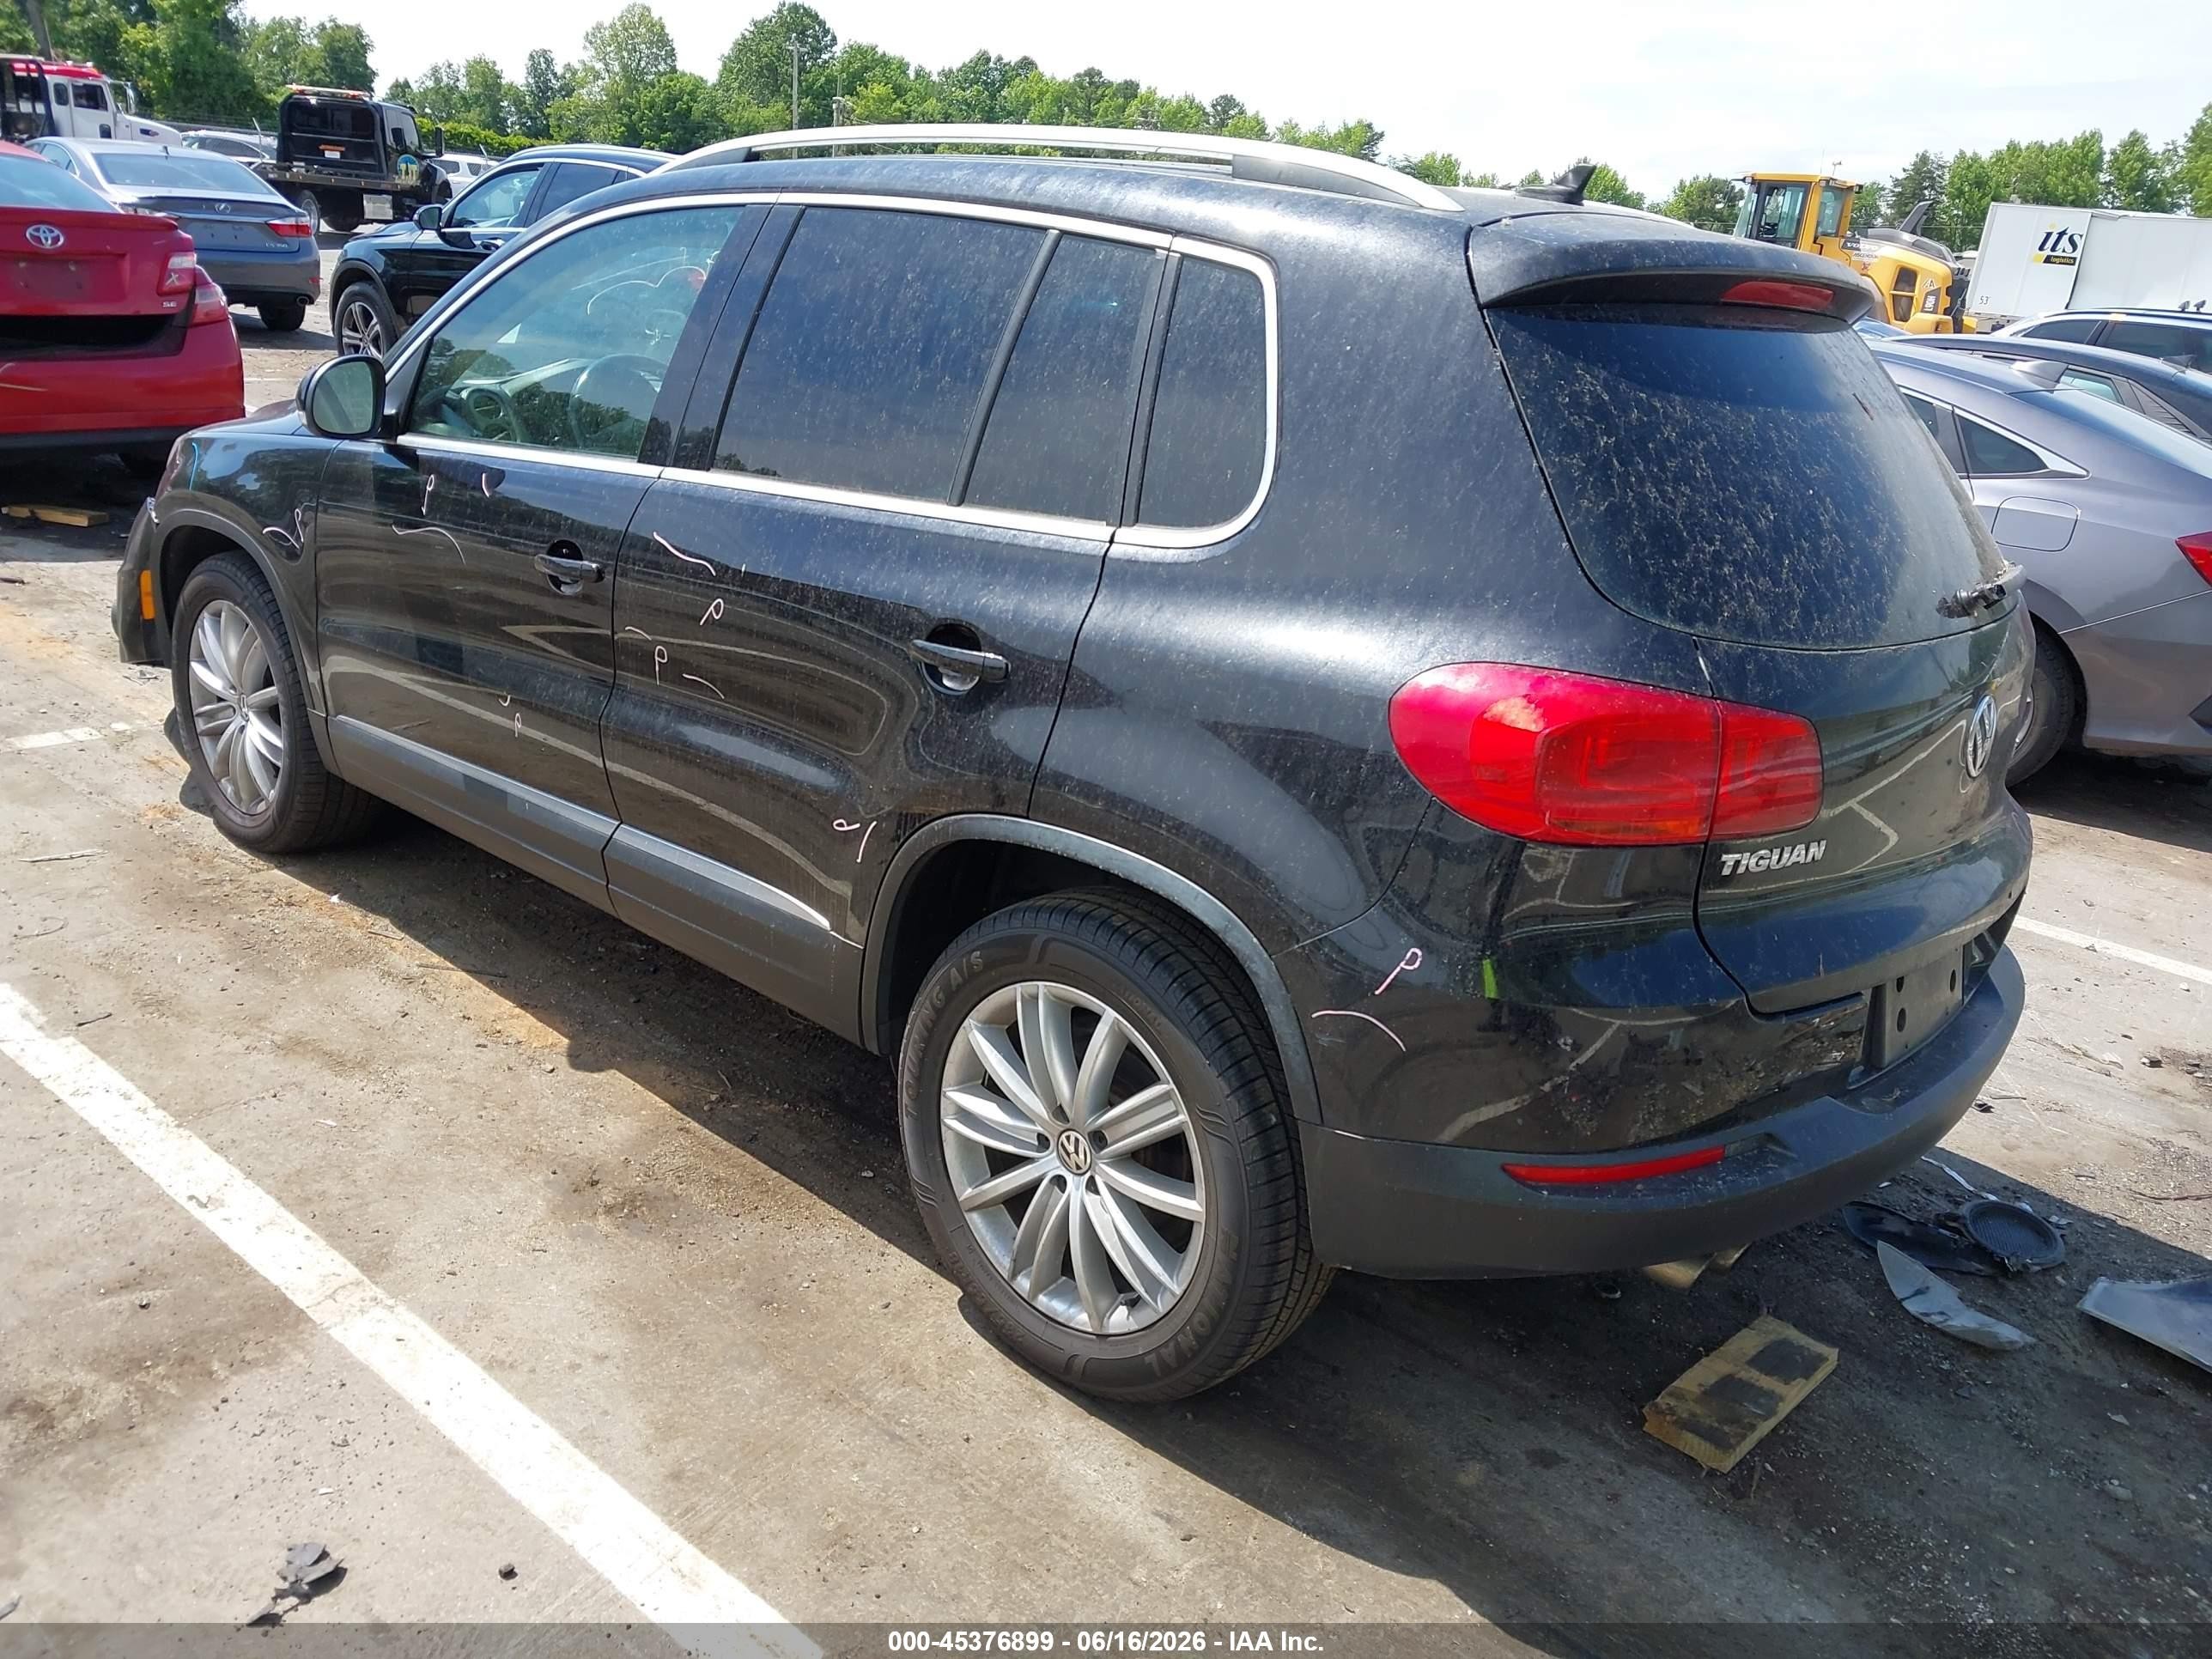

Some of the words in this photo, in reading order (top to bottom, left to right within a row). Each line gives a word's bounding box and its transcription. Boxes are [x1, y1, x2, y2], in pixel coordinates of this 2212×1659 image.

[2038, 222, 2084, 254] its
[2051, 256, 2074, 264] logistics
[1720, 839, 1827, 876] TIGUAN
